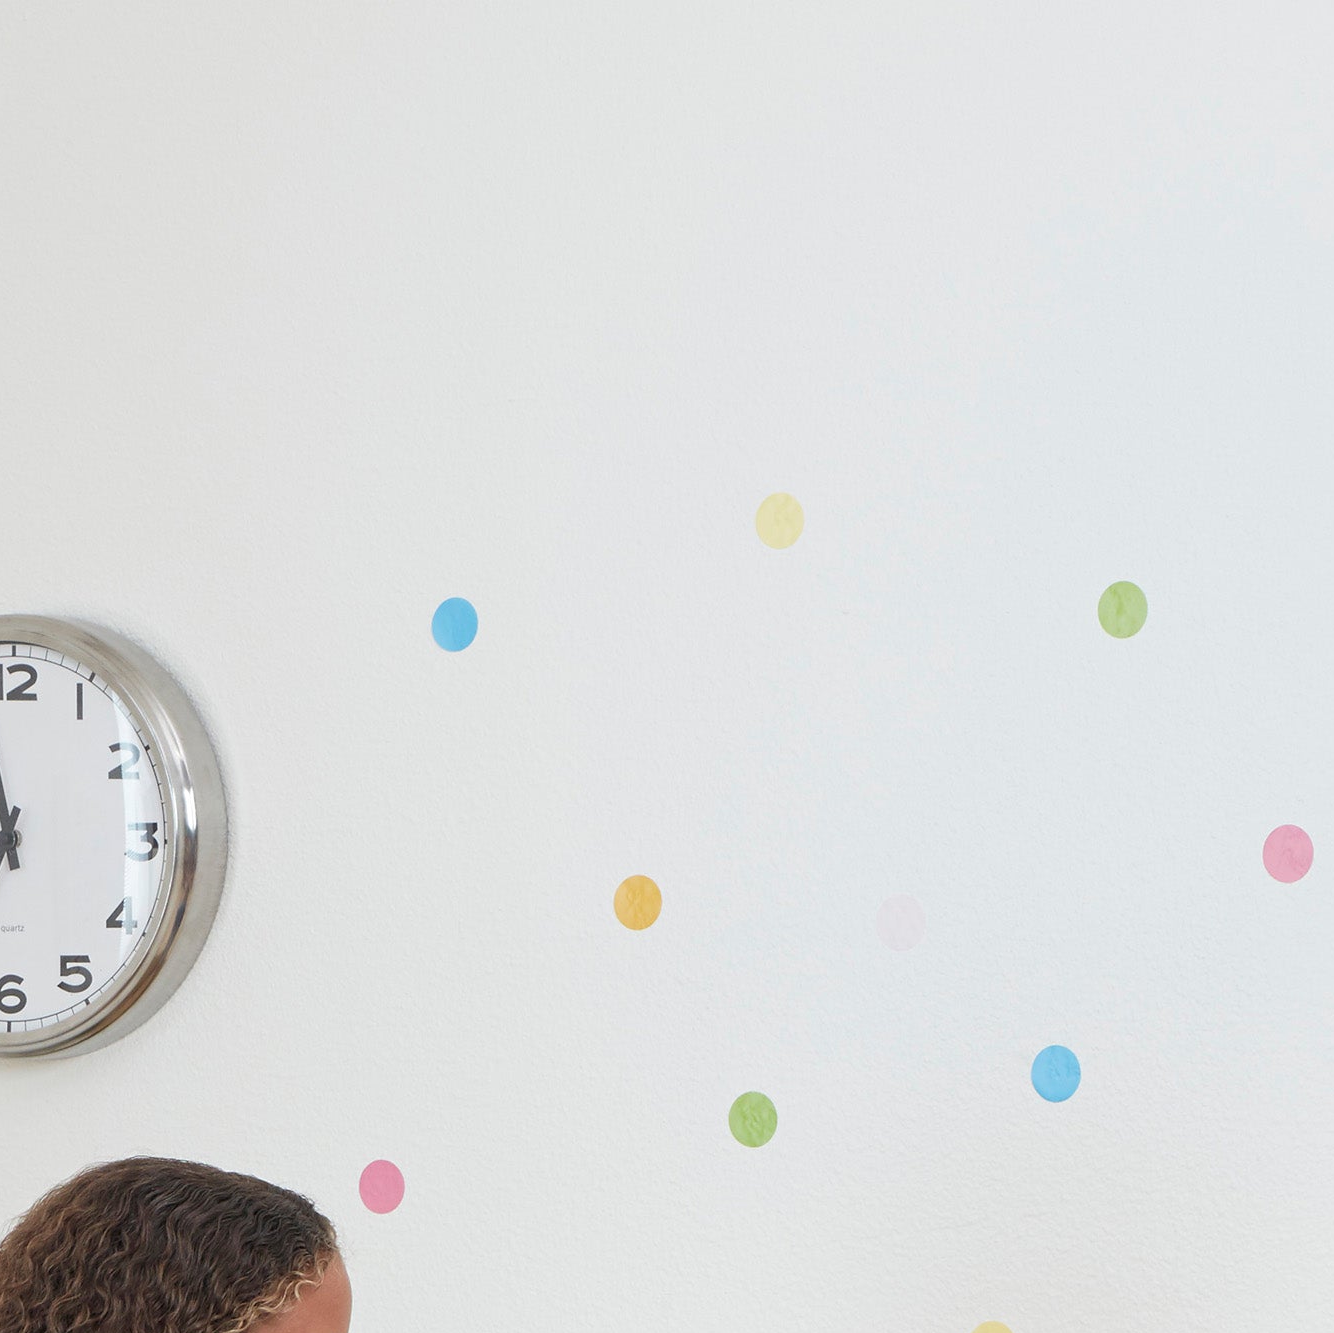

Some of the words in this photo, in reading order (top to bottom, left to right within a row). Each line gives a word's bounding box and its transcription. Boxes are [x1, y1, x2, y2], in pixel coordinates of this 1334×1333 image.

[76, 682, 84, 721] 1
[107, 741, 141, 780] 2
[124, 821, 159, 862] 3
[105, 895, 138, 935] 4
[56, 954, 93, 993] 5
